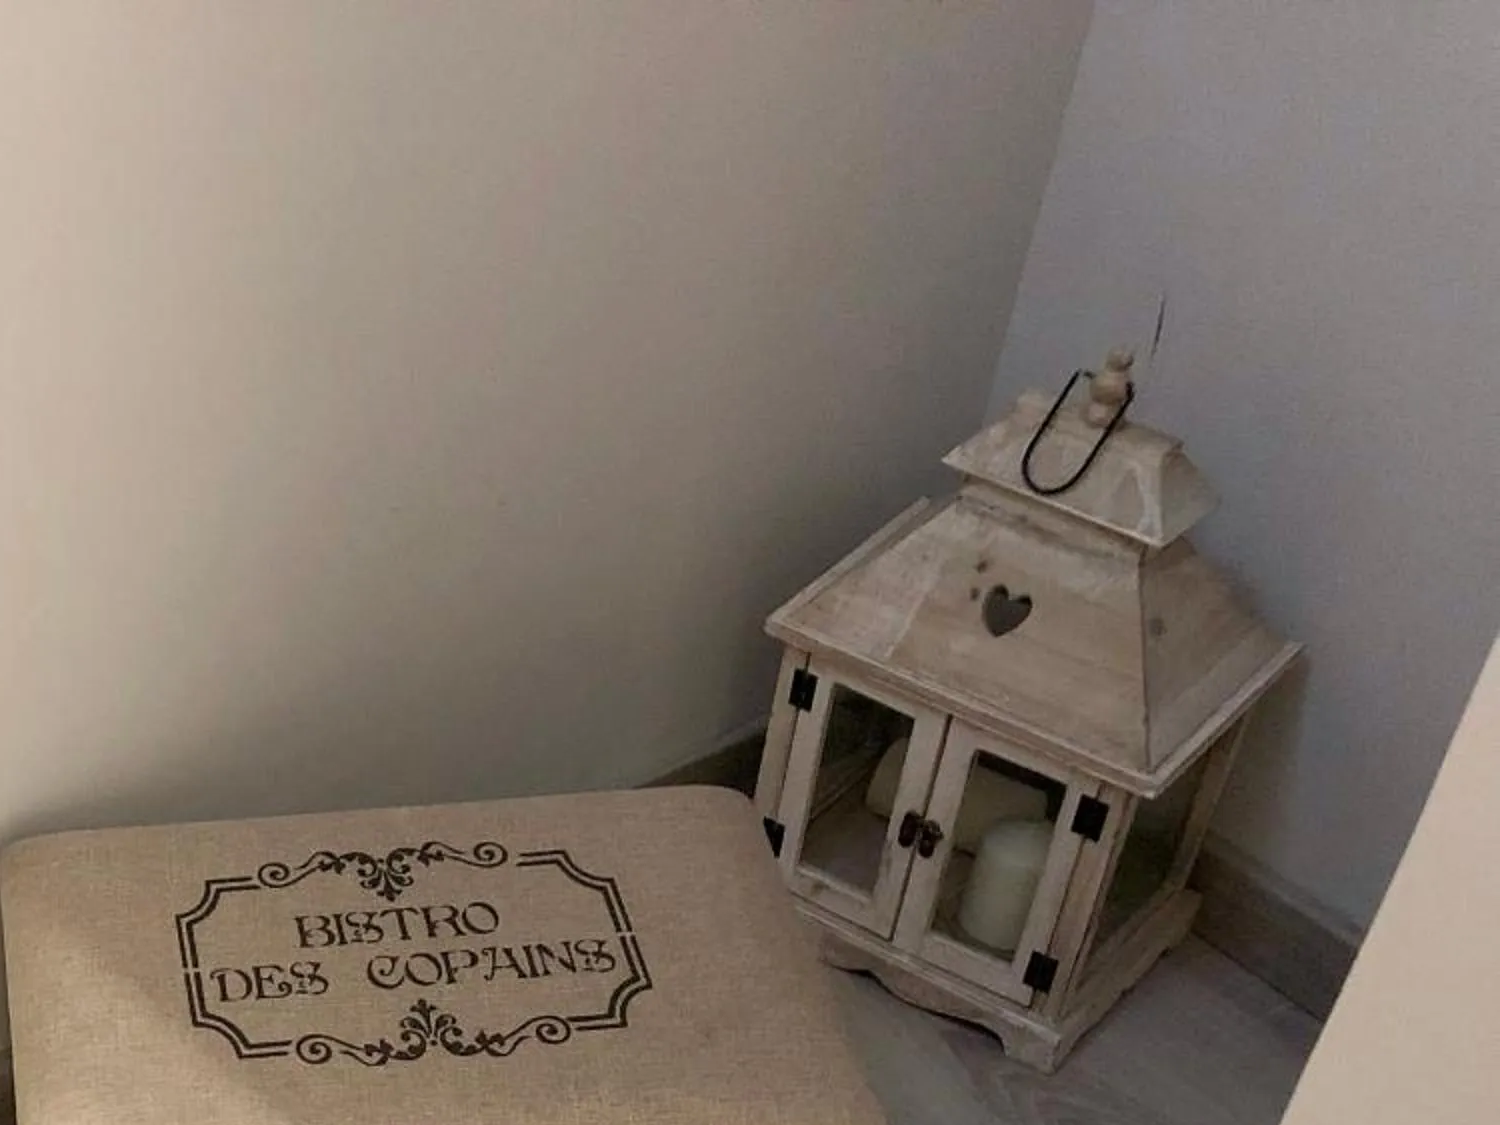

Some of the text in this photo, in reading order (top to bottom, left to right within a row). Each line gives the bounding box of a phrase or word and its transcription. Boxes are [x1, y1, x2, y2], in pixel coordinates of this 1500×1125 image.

[294, 901, 500, 948] BISTRO
[210, 939, 618, 1003] DES COPAINS
